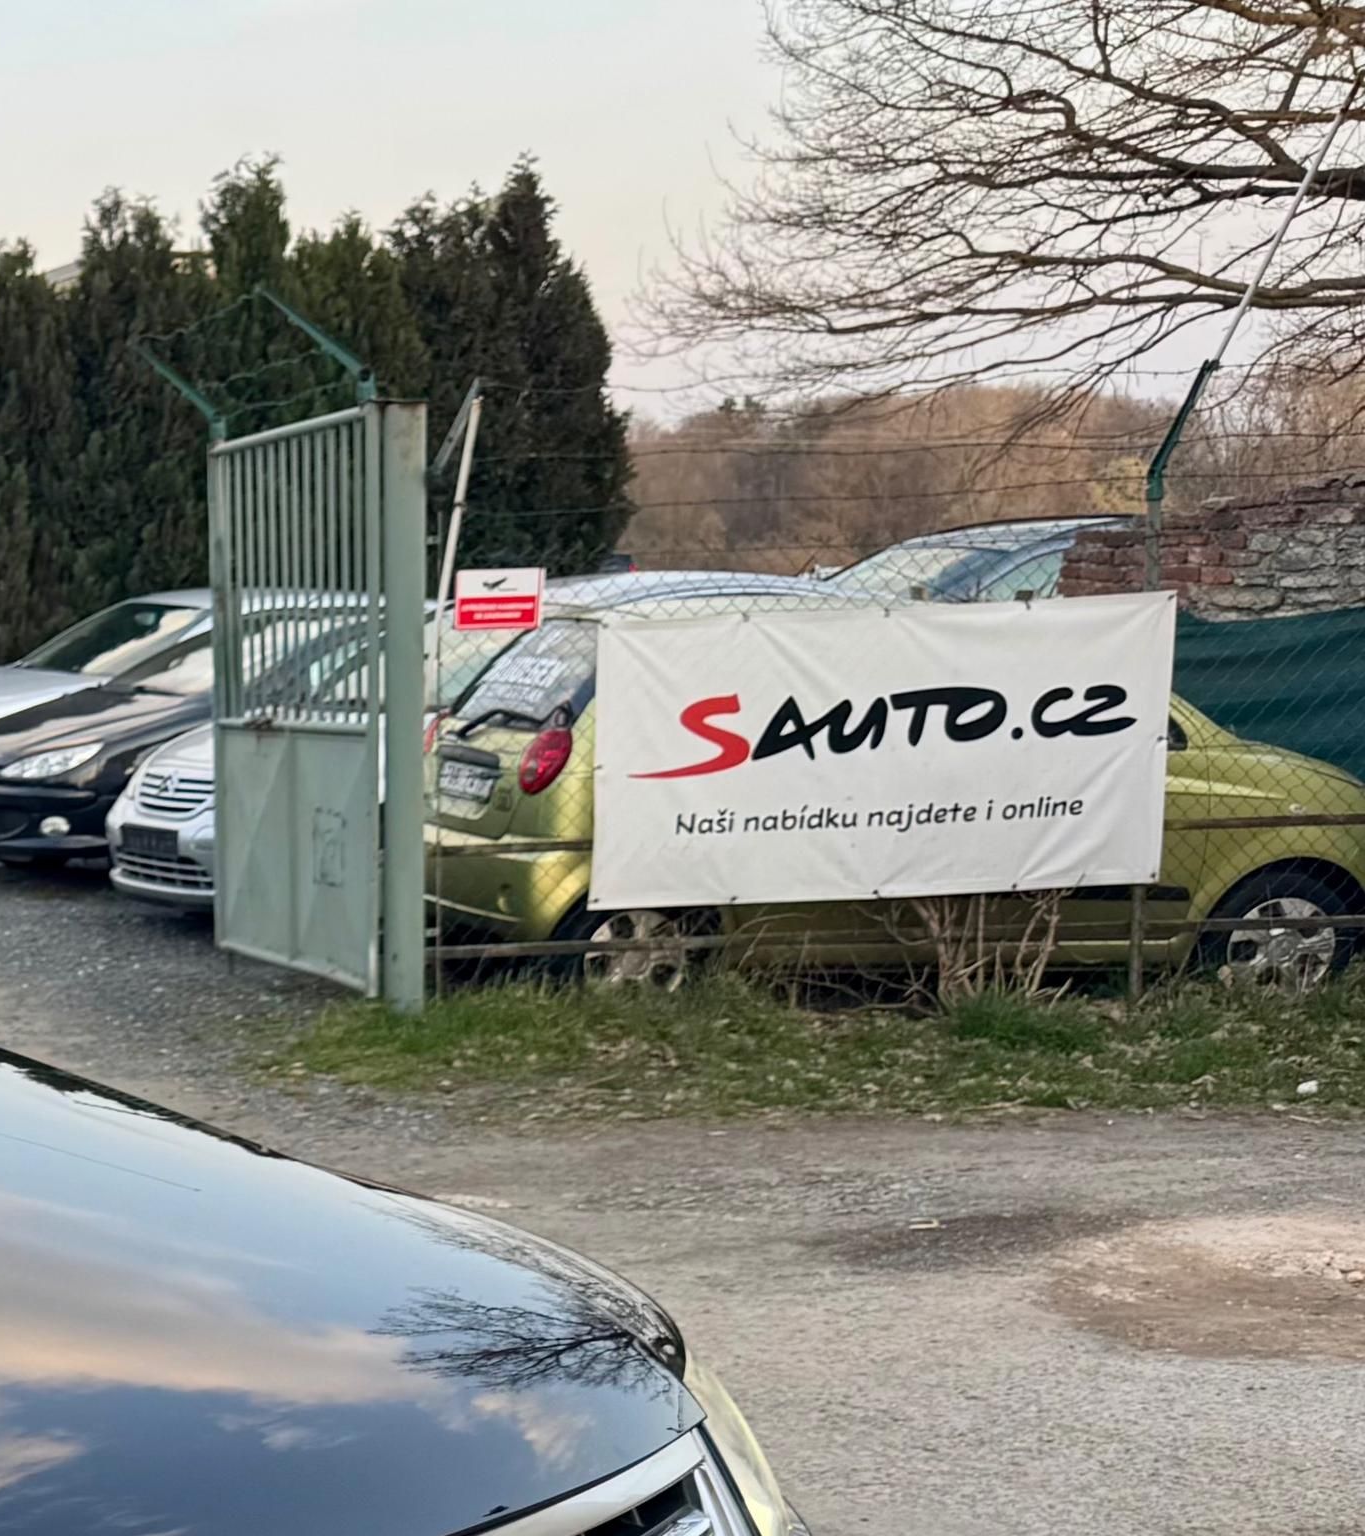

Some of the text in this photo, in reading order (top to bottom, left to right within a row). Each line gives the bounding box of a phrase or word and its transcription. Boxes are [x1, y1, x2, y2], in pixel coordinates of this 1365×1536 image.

[674, 796, 1085, 836] Naši nabídku najdete i online
